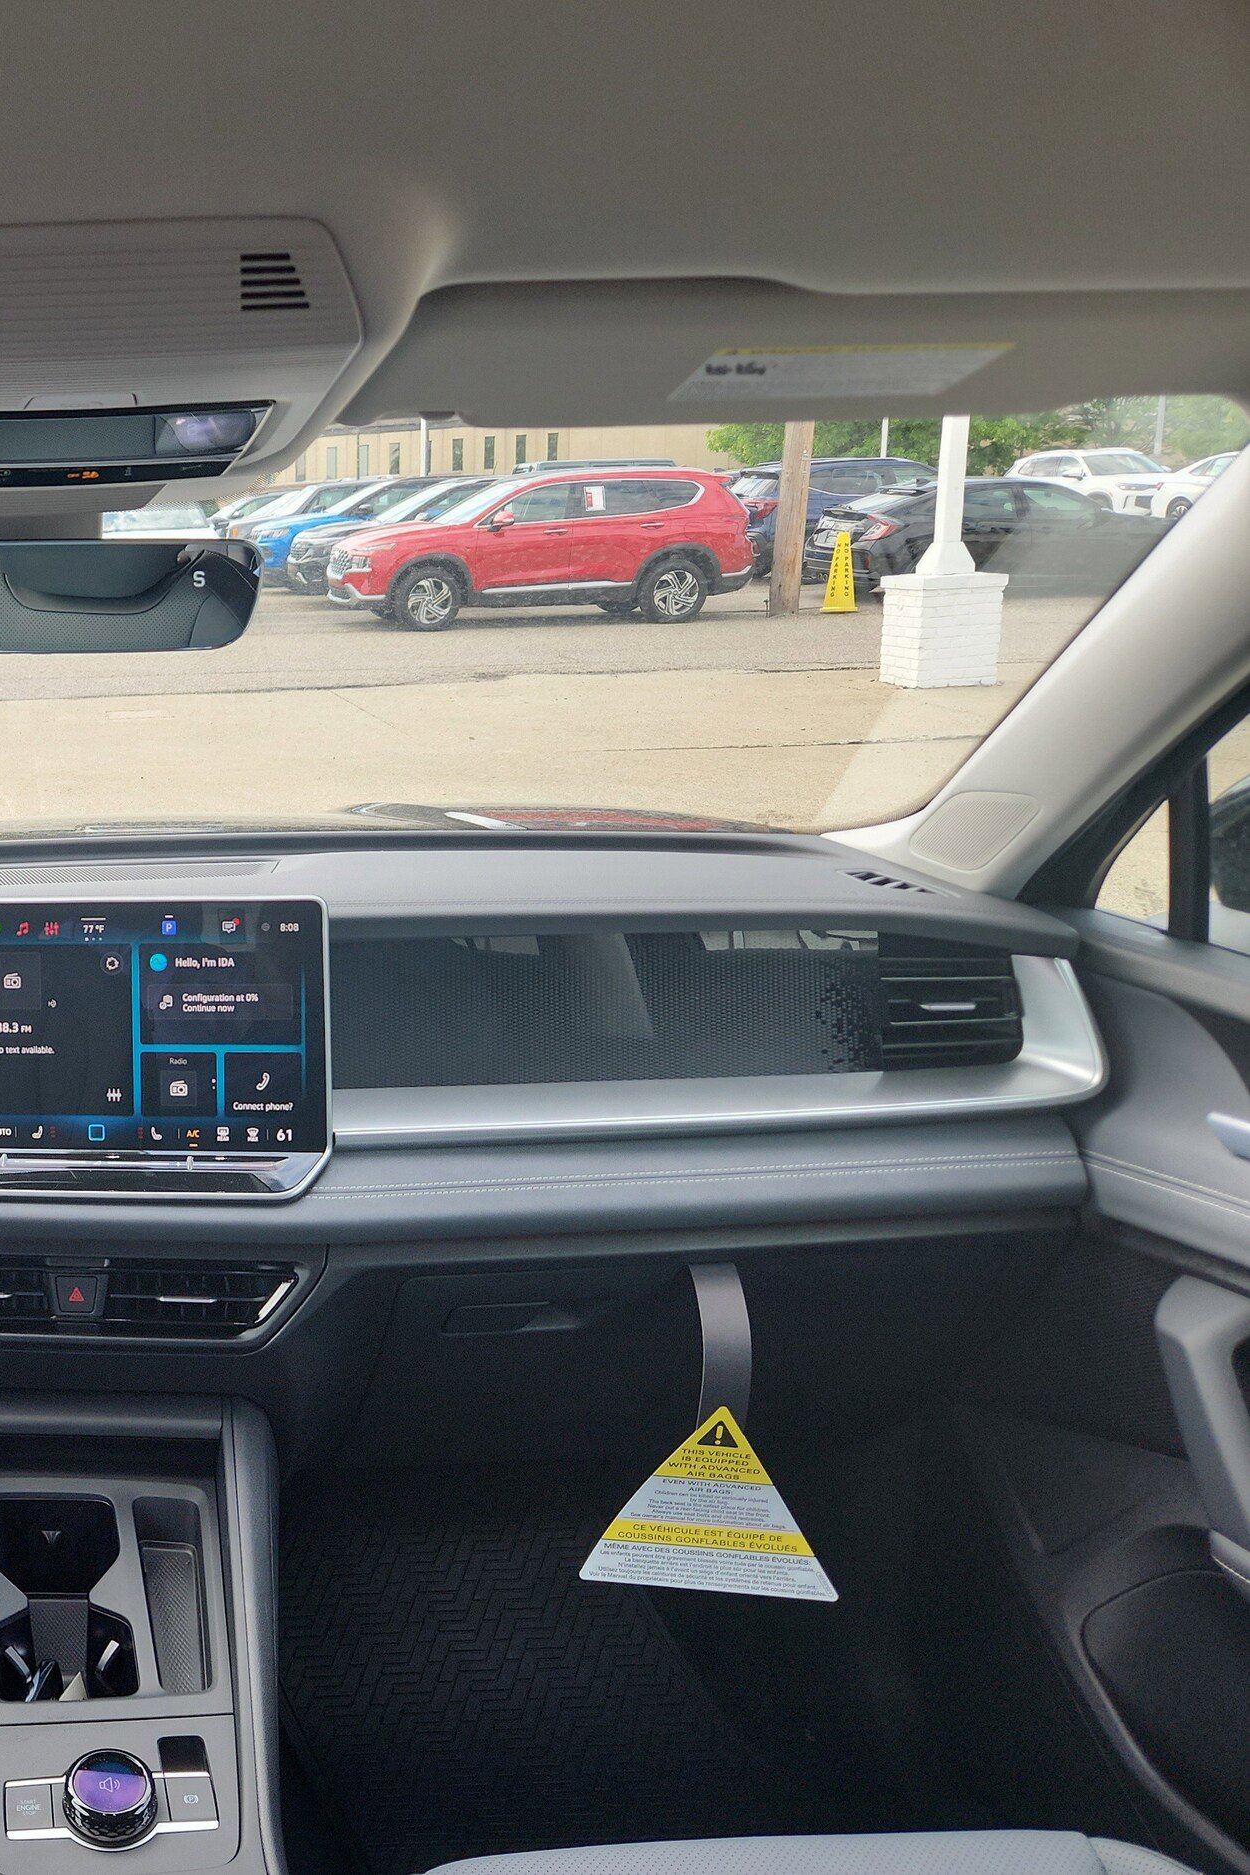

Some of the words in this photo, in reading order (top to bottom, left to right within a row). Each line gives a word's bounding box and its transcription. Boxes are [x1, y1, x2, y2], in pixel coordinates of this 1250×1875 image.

[193, 571, 205, 587] S
[83, 924, 94, 934] 77
[280, 923, 299, 932] 8:08
[175, 957, 200, 969] Hello,
[202, 957, 216, 968] I'm
[218, 957, 235, 968] IDA
[182, 993, 235, 1004] Configuration
[236, 993, 244, 1003] at
[245, 993, 259, 1003] 0%
[182, 1004, 216, 1013] Continue
[217, 1005, 235, 1013] now
[20, 1025, 32, 1033] FM
[5, 1045, 20, 1054] text
[21, 1045, 55, 1054] available.
[169, 1057, 188, 1065] Radio
[233, 1101, 264, 1111] Connect
[265, 1101, 294, 1112] phone?
[186, 1129, 200, 1138] A/C
[276, 1128, 293, 1142] 61
[707, 1450, 751, 1460] VEHICLE
[695, 1457, 749, 1466] EQUIPPED
[668, 1461, 697, 1469] WITH
[699, 1464, 761, 1475] ADVANCED
[712, 1482, 760, 1491] ADVANCED
[650, 1524, 699, 1536] VÉHICULE
[727, 1531, 766, 1540] ÉQUIPÉ
[617, 1530, 671, 1542] COUSSINS
[675, 1536, 746, 1548] GONFLABLES
[749, 1541, 798, 1552] ÉVOLUÉS
[672, 1548, 713, 1557] COUSSINS
[716, 1551, 770, 1562] GONFLABLES
